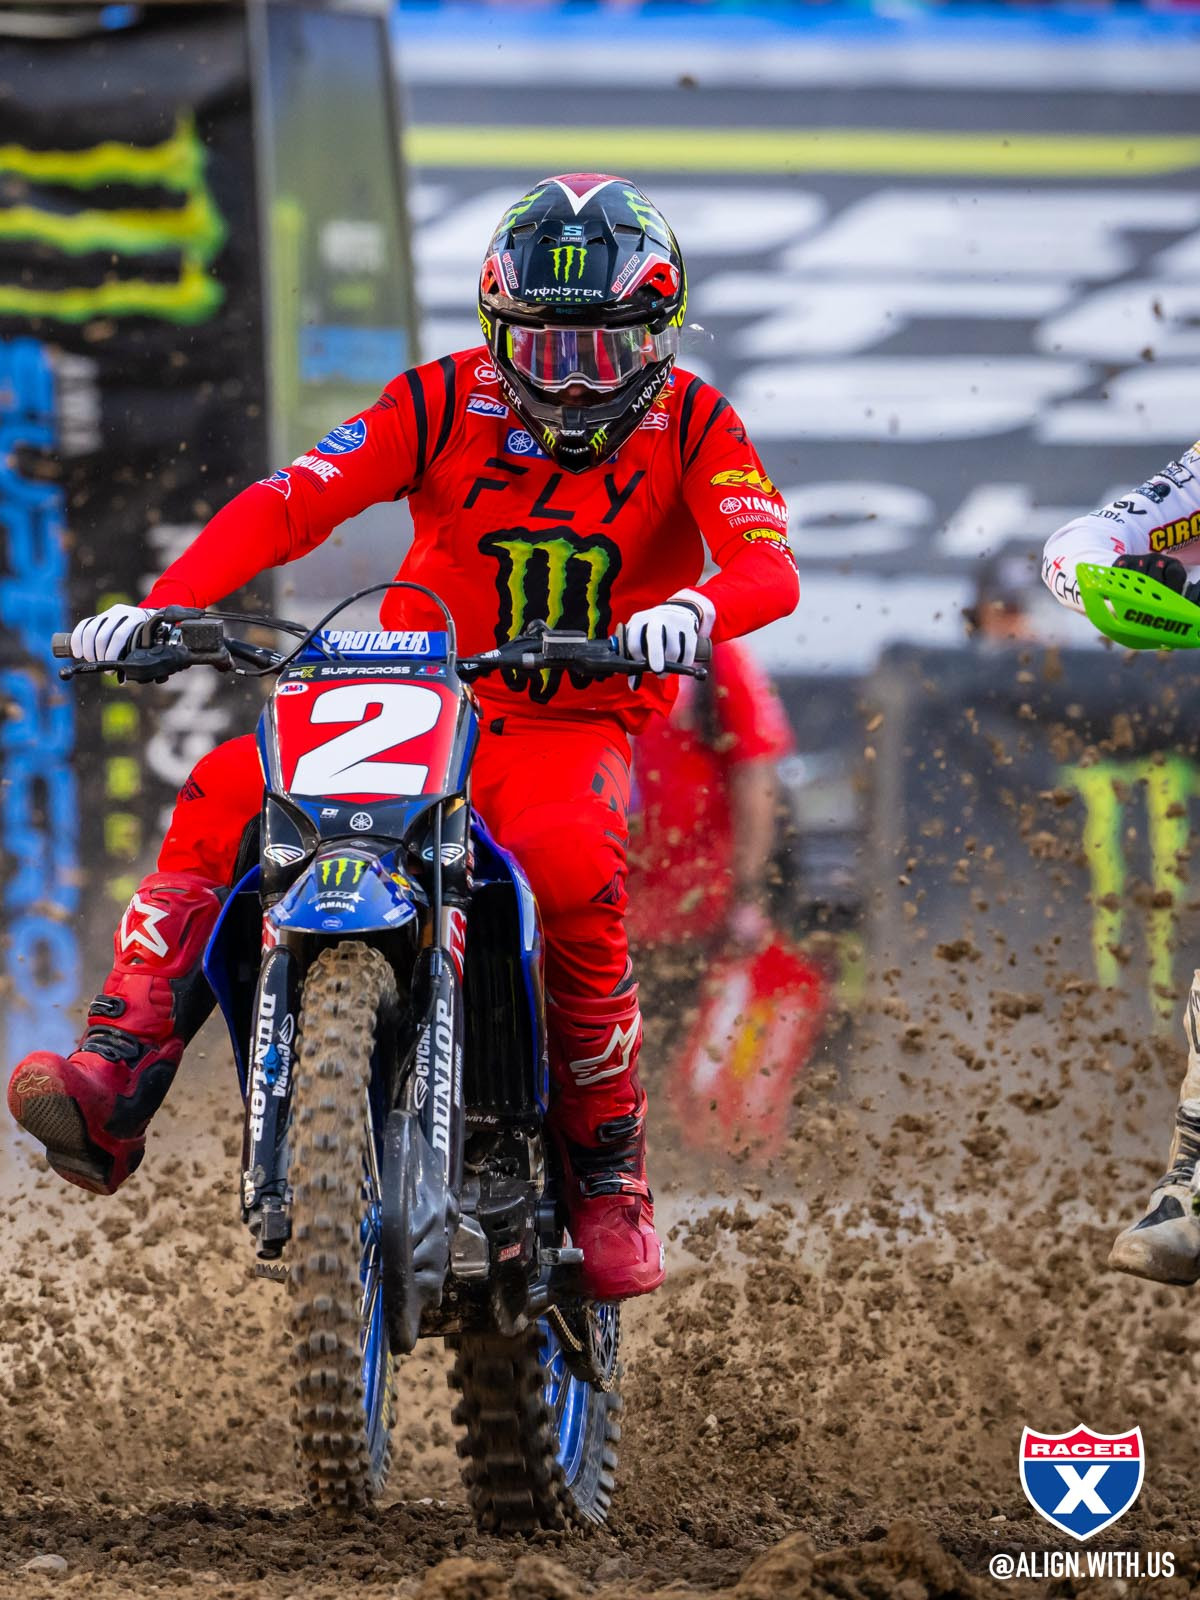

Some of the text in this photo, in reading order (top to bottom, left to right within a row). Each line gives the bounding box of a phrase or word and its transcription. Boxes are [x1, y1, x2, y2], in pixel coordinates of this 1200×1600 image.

[524, 286, 604, 299] MONSTER
[631, 355, 675, 413] MONST
[462, 456, 647, 525] FLY
[740, 496, 790, 523] YAMAH
[1123, 608, 1194, 636] CIRCUIT
[326, 631, 425, 654] PROTAPER
[321, 666, 411, 676] SUPERCROSS
[289, 682, 443, 796] 2
[314, 901, 356, 913] YAMAHA
[432, 998, 453, 1152] DUNLOP
